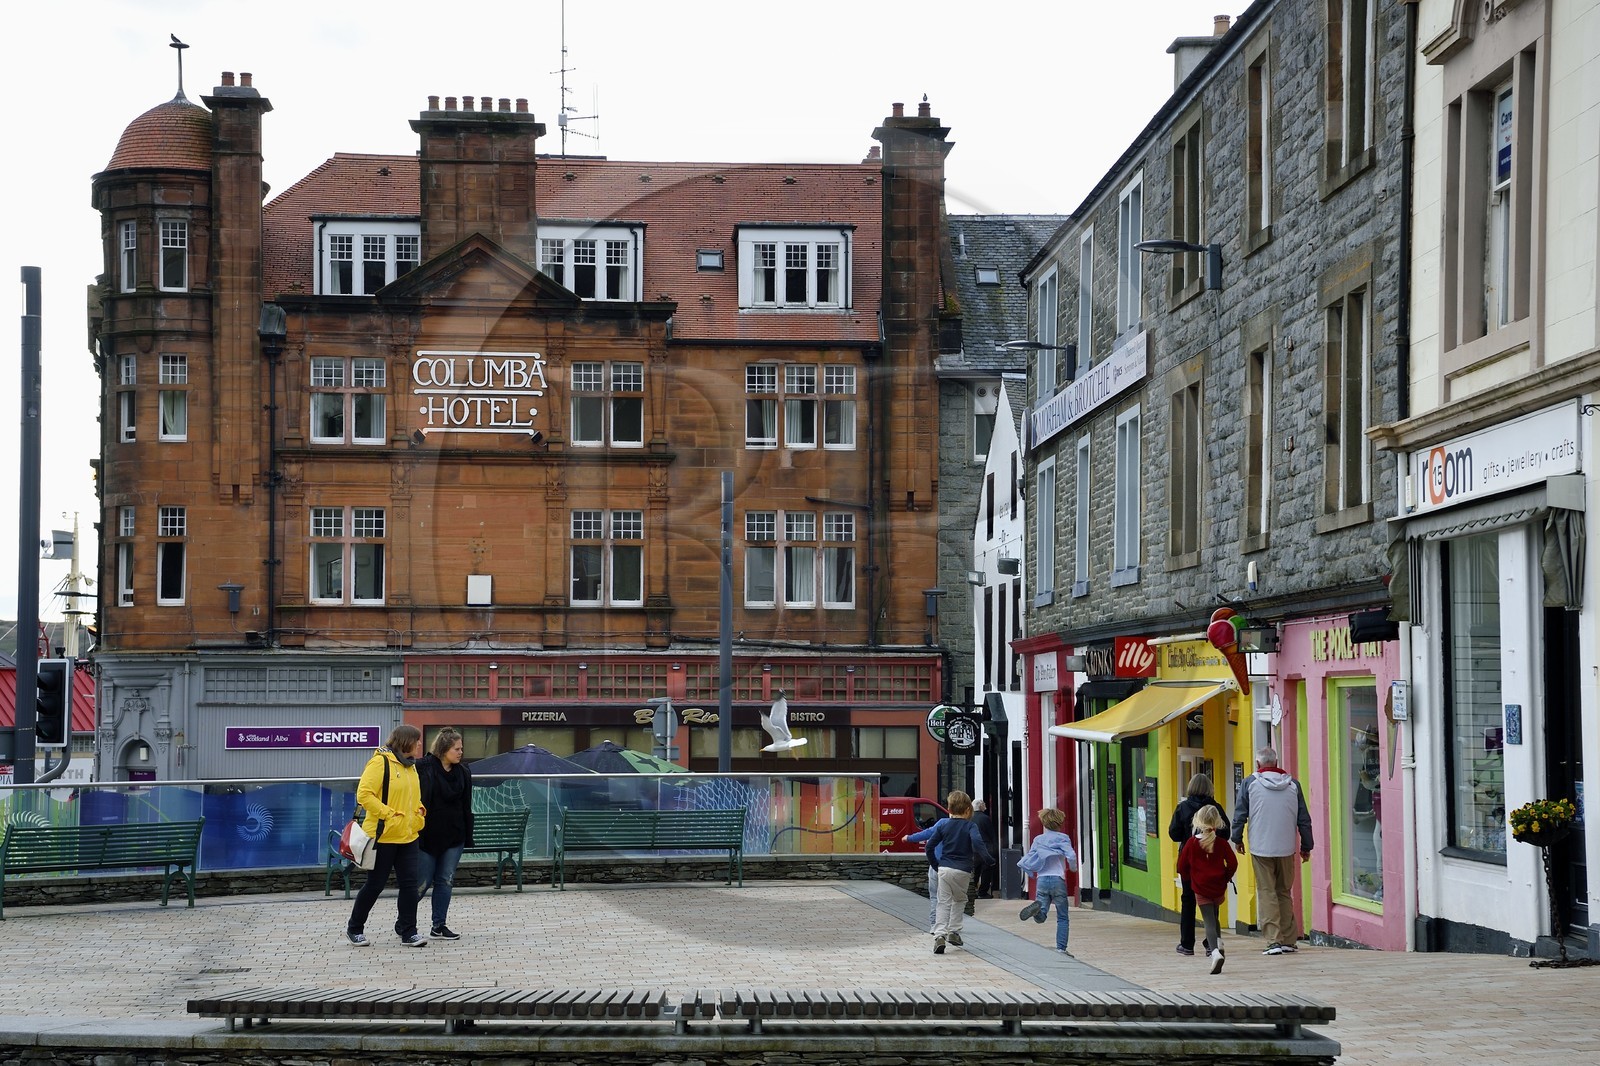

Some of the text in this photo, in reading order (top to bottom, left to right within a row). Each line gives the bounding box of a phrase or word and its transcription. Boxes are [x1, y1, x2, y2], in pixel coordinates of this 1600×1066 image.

[413, 358, 548, 388] COLUMBA
[1067, 390, 1074, 421] &
[1074, 362, 1111, 417] BROTCHIE
[427, 397, 533, 426] HOTEL
[1432, 465, 1443, 486] 15
[1483, 438, 1574, 484] gifts jewellery crafts
[1118, 641, 1154, 674] illy
[1309, 629, 1327, 661] THE
[521, 711, 567, 722] PIZZERIA
[681, 708, 720, 724] Rio
[790, 711, 826, 722] BISTRO
